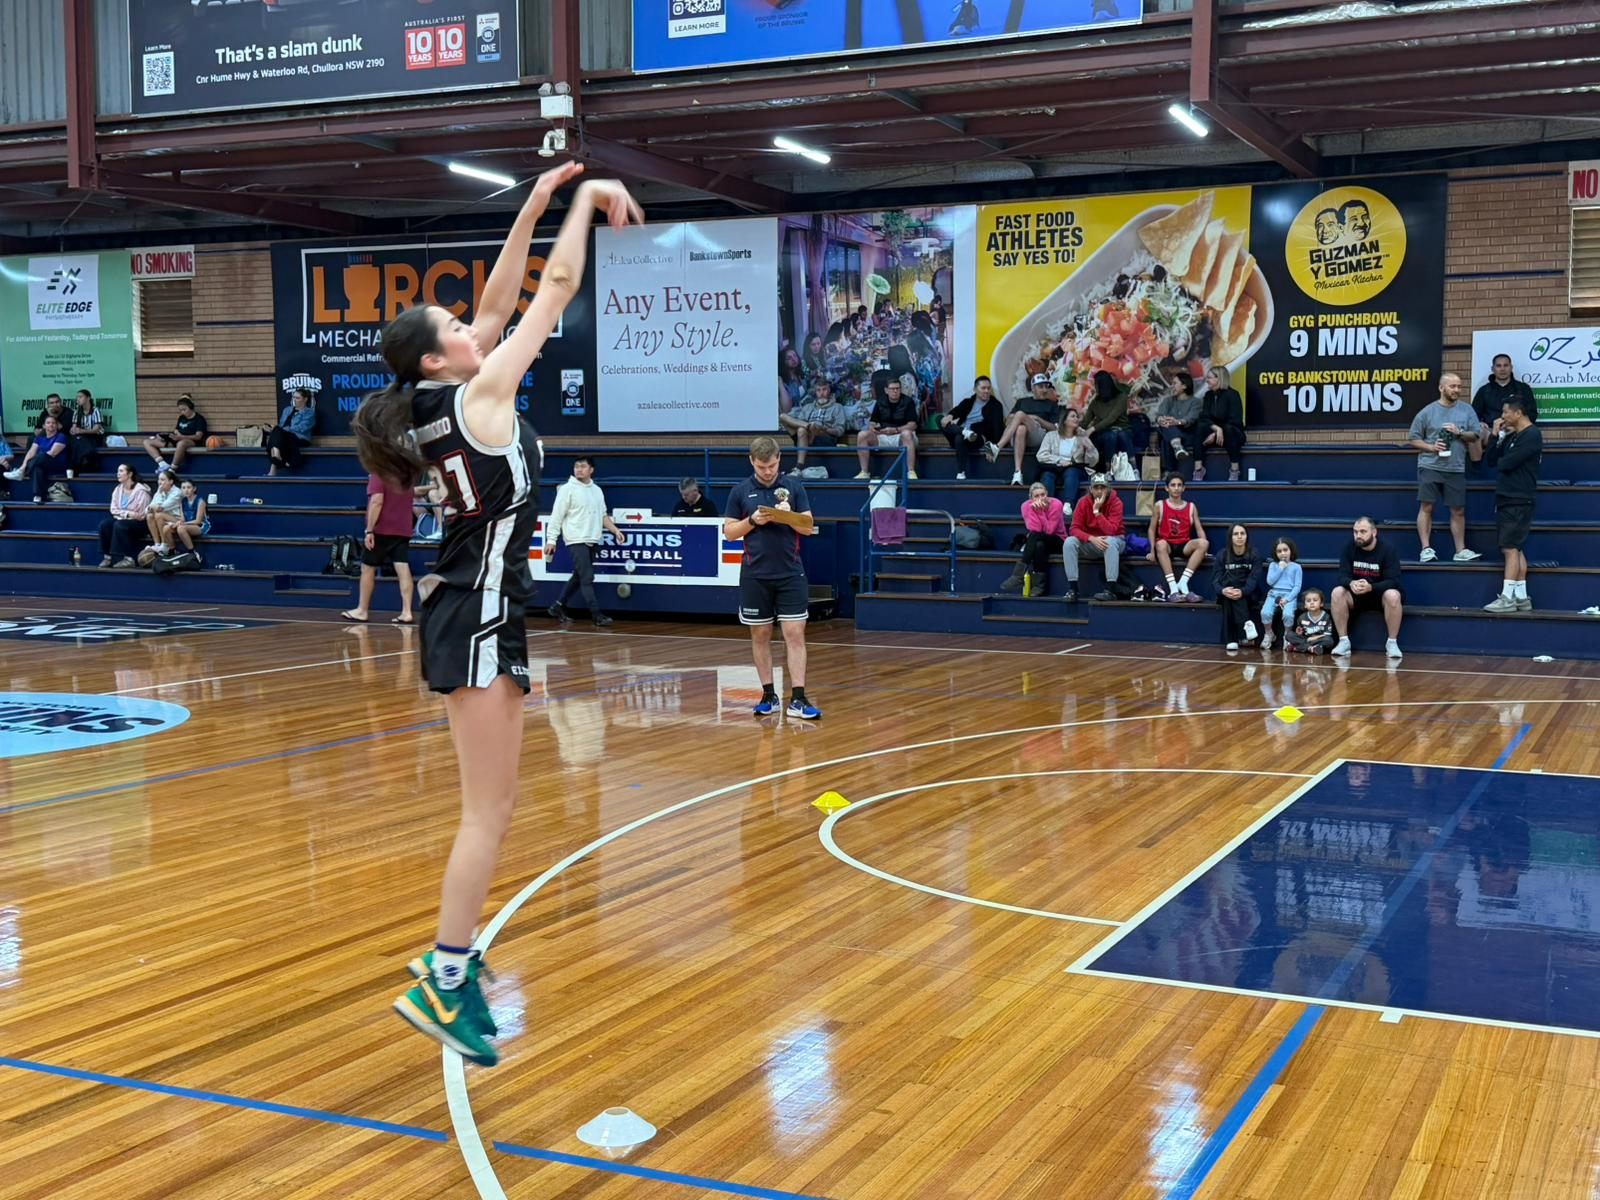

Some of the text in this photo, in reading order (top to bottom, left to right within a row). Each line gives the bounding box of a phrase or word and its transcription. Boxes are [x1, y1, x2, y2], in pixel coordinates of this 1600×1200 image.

[404, 17, 445, 27] AUSTRALIA'S
[674, 21, 720, 32] LEARN MORE
[408, 31, 432, 54] 10
[438, 27, 463, 51] 10
[215, 34, 363, 65] That's a slam dunk
[438, 49, 463, 59] YEARS
[480, 43, 497, 53] ONE
[408, 53, 432, 63] YEARS
[196, 58, 385, 85] Cnr Hume Hwy & Waterloo Rd, Chullora NSW 2190
[1572, 169, 1599, 199] NO
[995, 211, 1075, 230] FAST FOOD
[986, 227, 1083, 251] ATHLETES
[689, 249, 752, 262] BankstownSports
[993, 249, 1076, 266] SAY YES TO!
[1309, 240, 1380, 264] GUZMAN
[131, 250, 193, 275] NO SMOKING
[1310, 256, 1383, 280] Y GOMEZ
[1314, 274, 1384, 290] Mexican Kitchen
[36, 301, 93, 314] ELITE EDGE
[603, 286, 751, 320] Any Event,
[1289, 312, 1400, 328] GYG PUNCHBOWL
[319, 327, 382, 348] MECHA
[613, 320, 739, 357] Any Style.
[1289, 325, 1399, 357] 9 MINS
[321, 353, 366, 363] Commercial
[601, 361, 752, 375] Celebrations, Weddings & Events
[282, 376, 323, 391] BRUINS
[331, 373, 397, 389] PROUDLY
[1259, 368, 1429, 385] GYG BANKSTOWN AIRPORT
[1521, 373, 1541, 384] OZ
[1544, 372, 1574, 383] Arab
[565, 398, 581, 407] ONE
[1283, 382, 1403, 413] 10 MINS
[1534, 391, 1559, 400] tralian
[22, 399, 47, 411] PROUDL
[96, 398, 113, 410] WITH
[637, 399, 720, 410] azaleacollective.com
[598, 533, 682, 547] RUINS
[596, 549, 683, 560] SKETBALL
